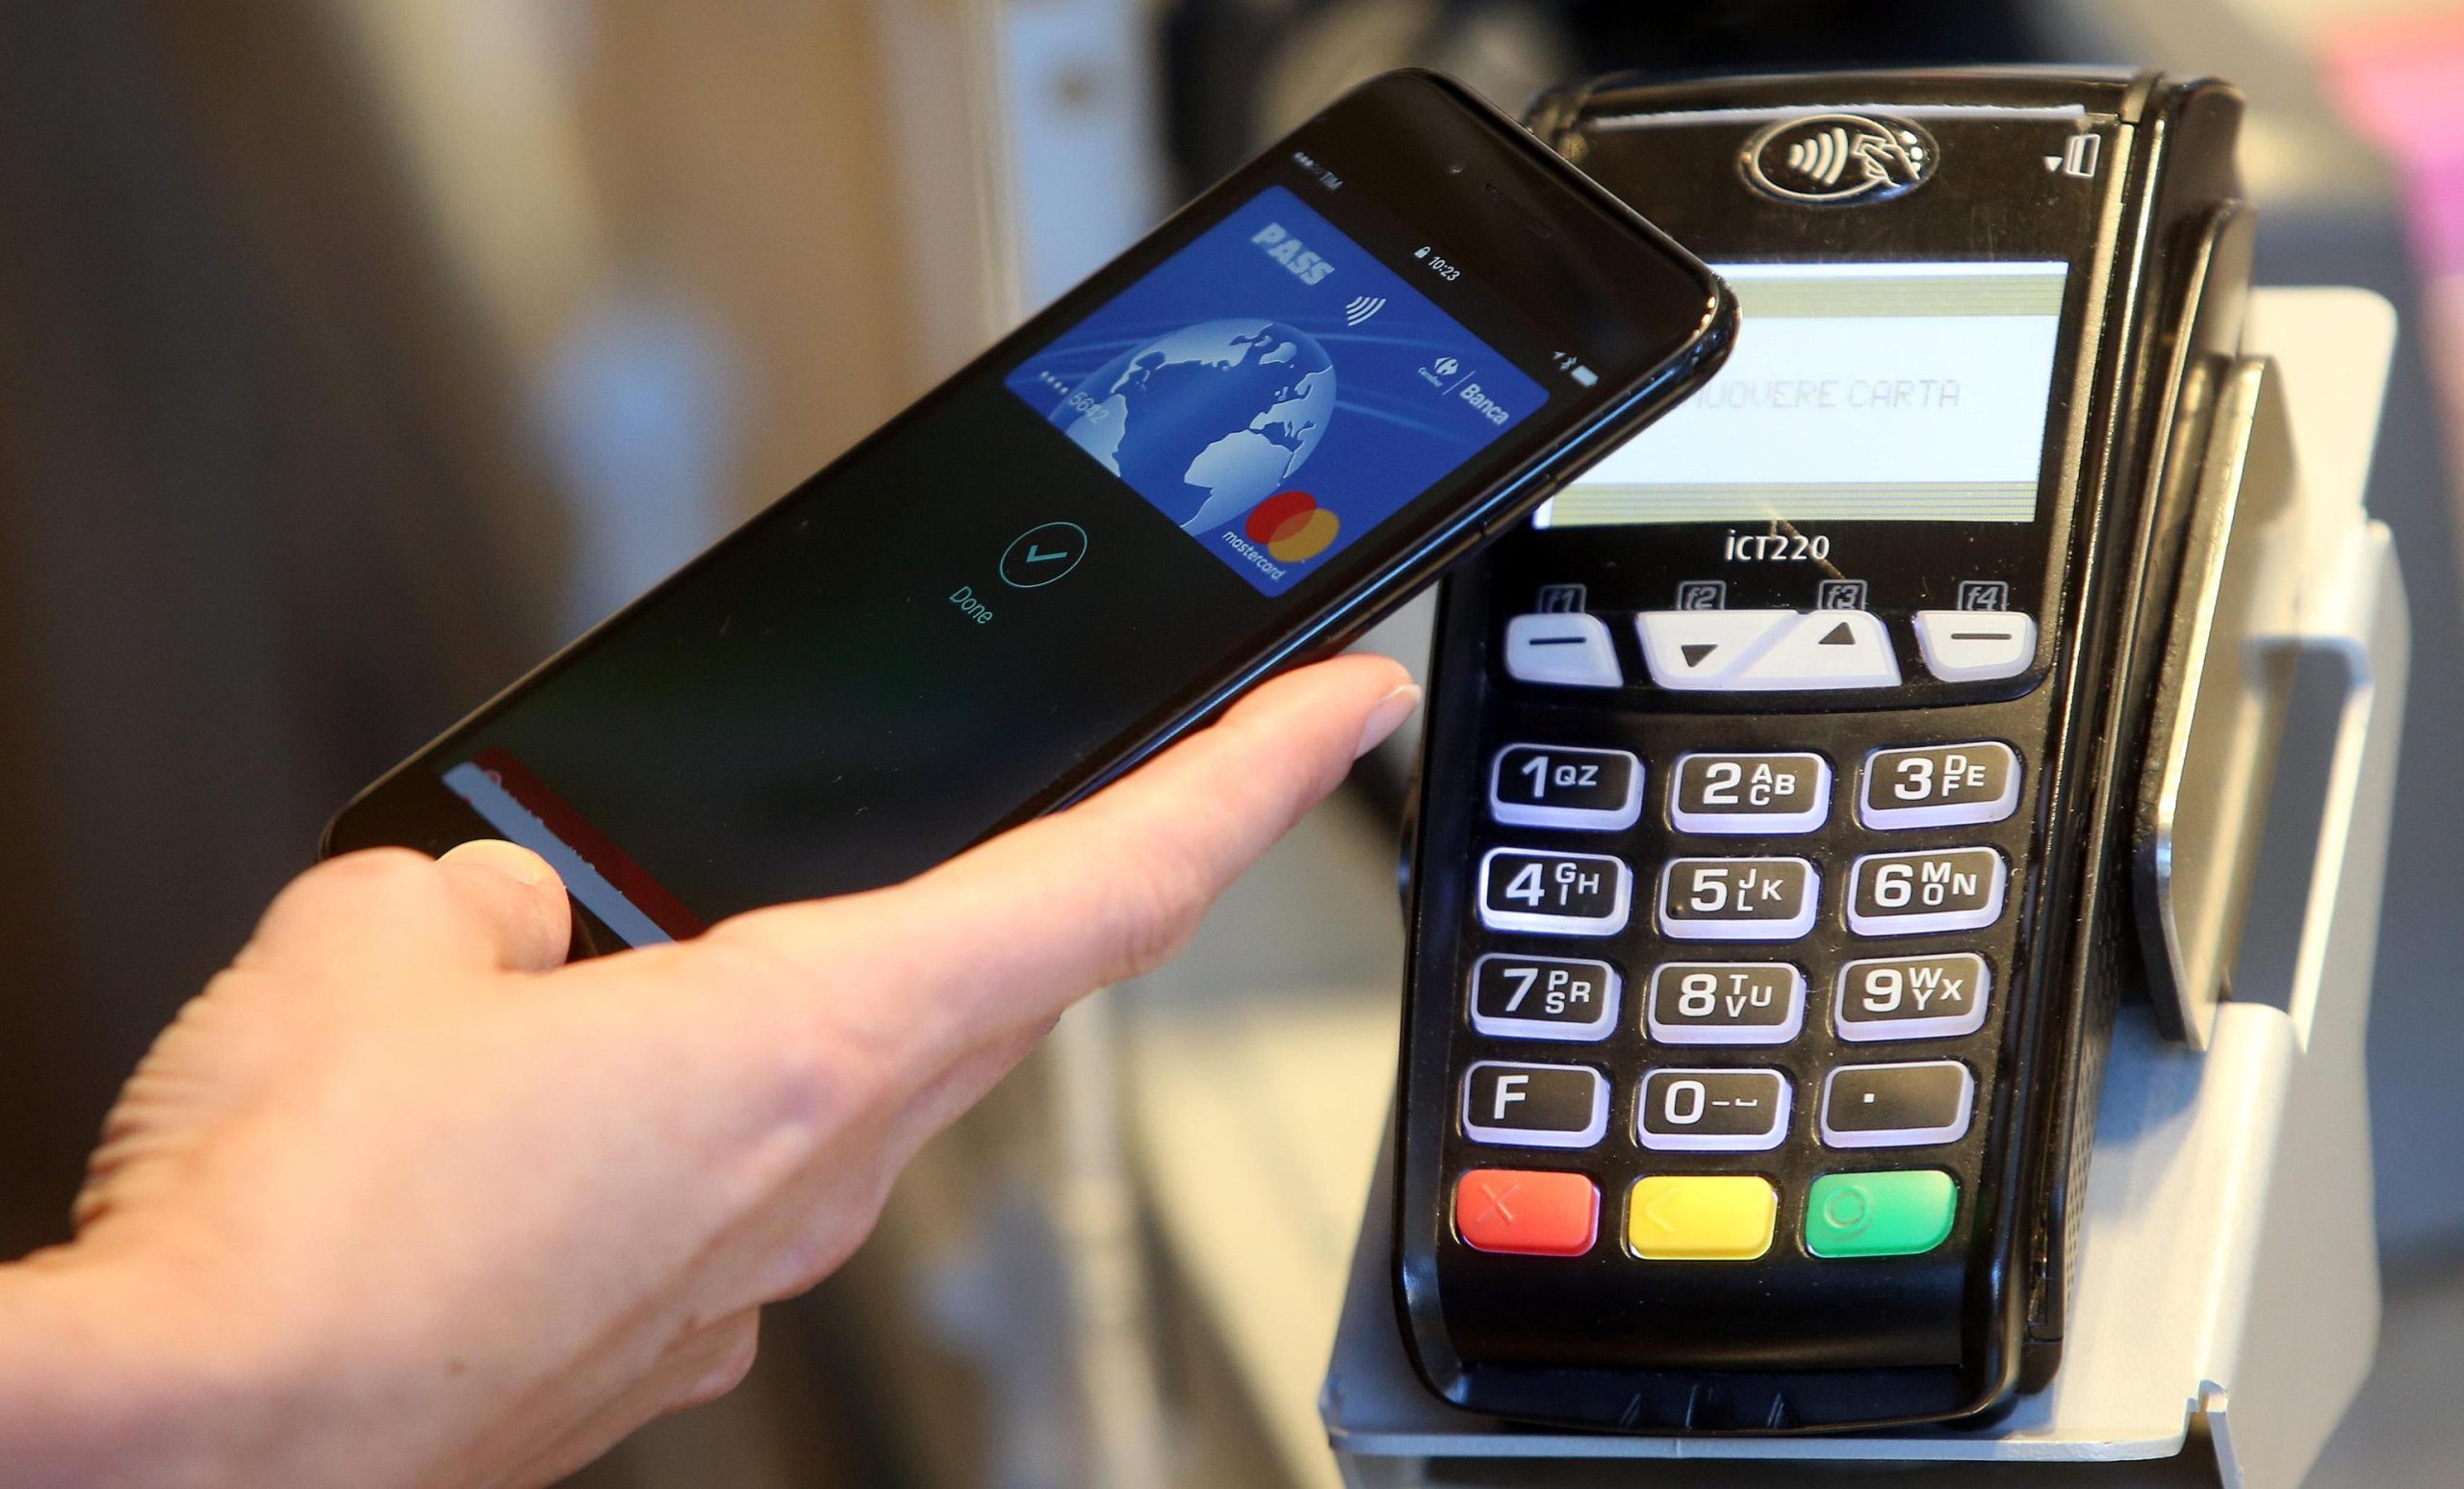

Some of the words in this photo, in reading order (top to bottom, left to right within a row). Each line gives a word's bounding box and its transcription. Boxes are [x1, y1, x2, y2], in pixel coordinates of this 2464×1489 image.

[1251, 222, 1335, 286] PASS
[1428, 254, 1461, 282] 10:23
[1460, 383, 1509, 425] Banca
[1691, 379, 1840, 409] UOVERE
[1848, 379, 1962, 408] CARTA
[1222, 531, 1288, 581] mastercard
[1725, 529, 1831, 561] iCT220
[949, 585, 994, 626] Done
[1523, 756, 1548, 798] 1
[1554, 764, 1599, 788] QZ
[1703, 761, 1741, 806] 2
[1893, 757, 1933, 802] 3
[1505, 862, 1545, 907] 4
[1690, 868, 1728, 912] 5
[1873, 863, 1913, 908] 6
[1502, 968, 1539, 1013] 7
[1679, 974, 1718, 1016] 8
[1863, 968, 1903, 1014] 9
[1494, 1075, 1529, 1120] F
